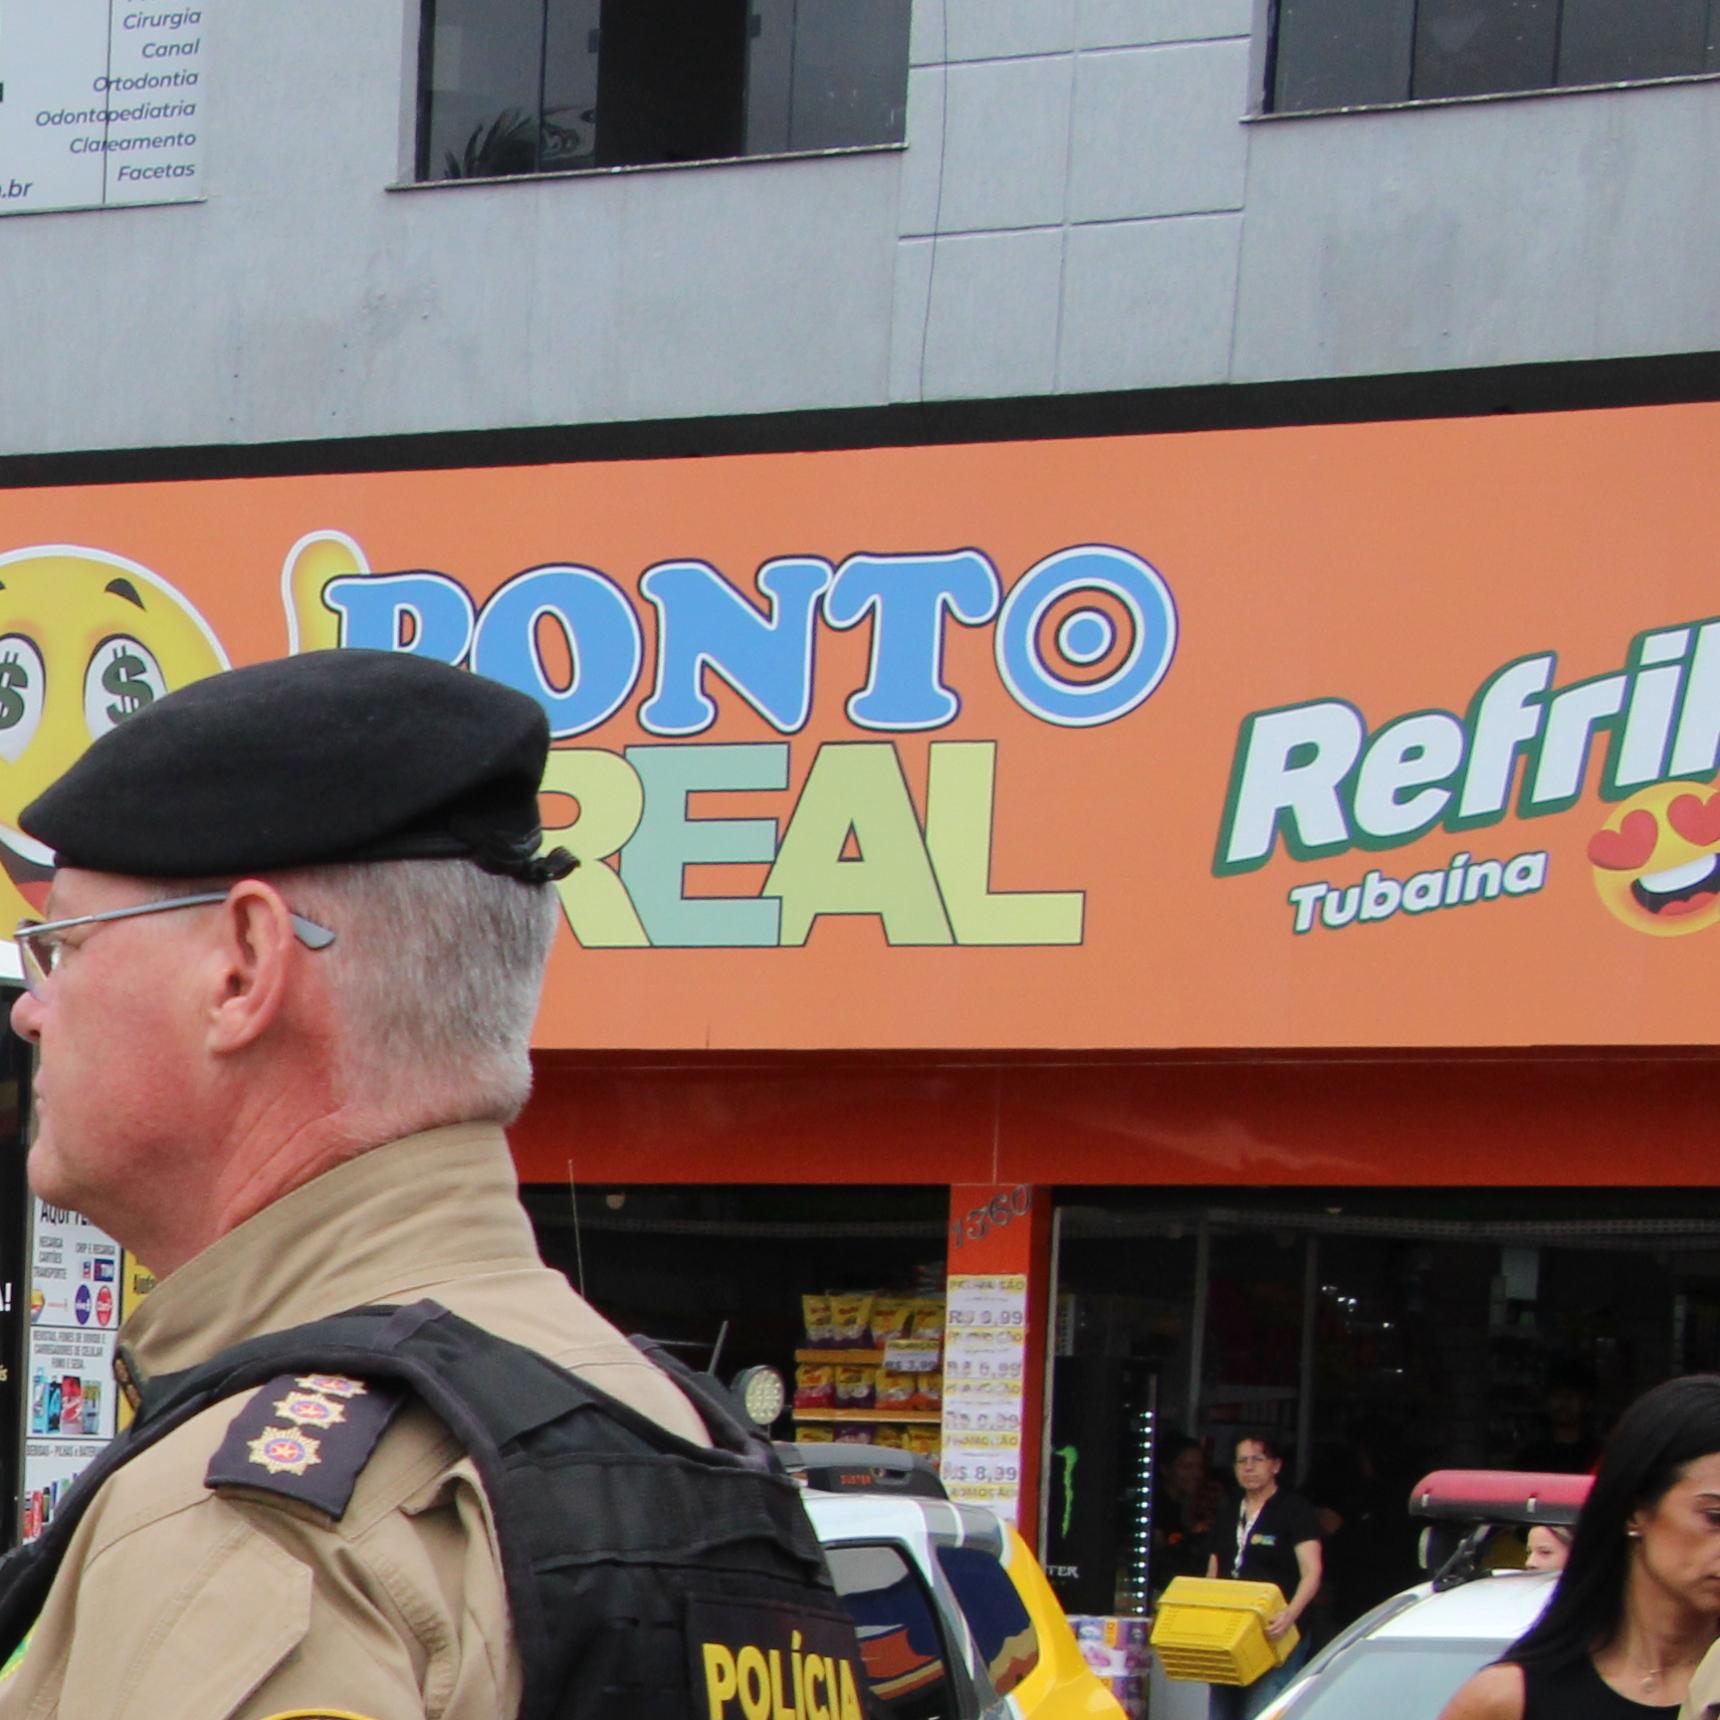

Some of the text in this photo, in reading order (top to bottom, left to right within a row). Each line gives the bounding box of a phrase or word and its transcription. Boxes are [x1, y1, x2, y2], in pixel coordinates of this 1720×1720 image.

[123, 8, 202, 29] Cirurgia
[142, 38, 201, 58] Canal
[93, 69, 199, 92] Ortodontia
[35, 100, 197, 127] Odontopediatria
[69, 133, 197, 154] Clareamento
[117, 163, 196, 181] Facetas
[324, 544, 1178, 740] PONTO
[538, 741, 1086, 948] REAL
[1289, 851, 1548, 935] Tubaína
